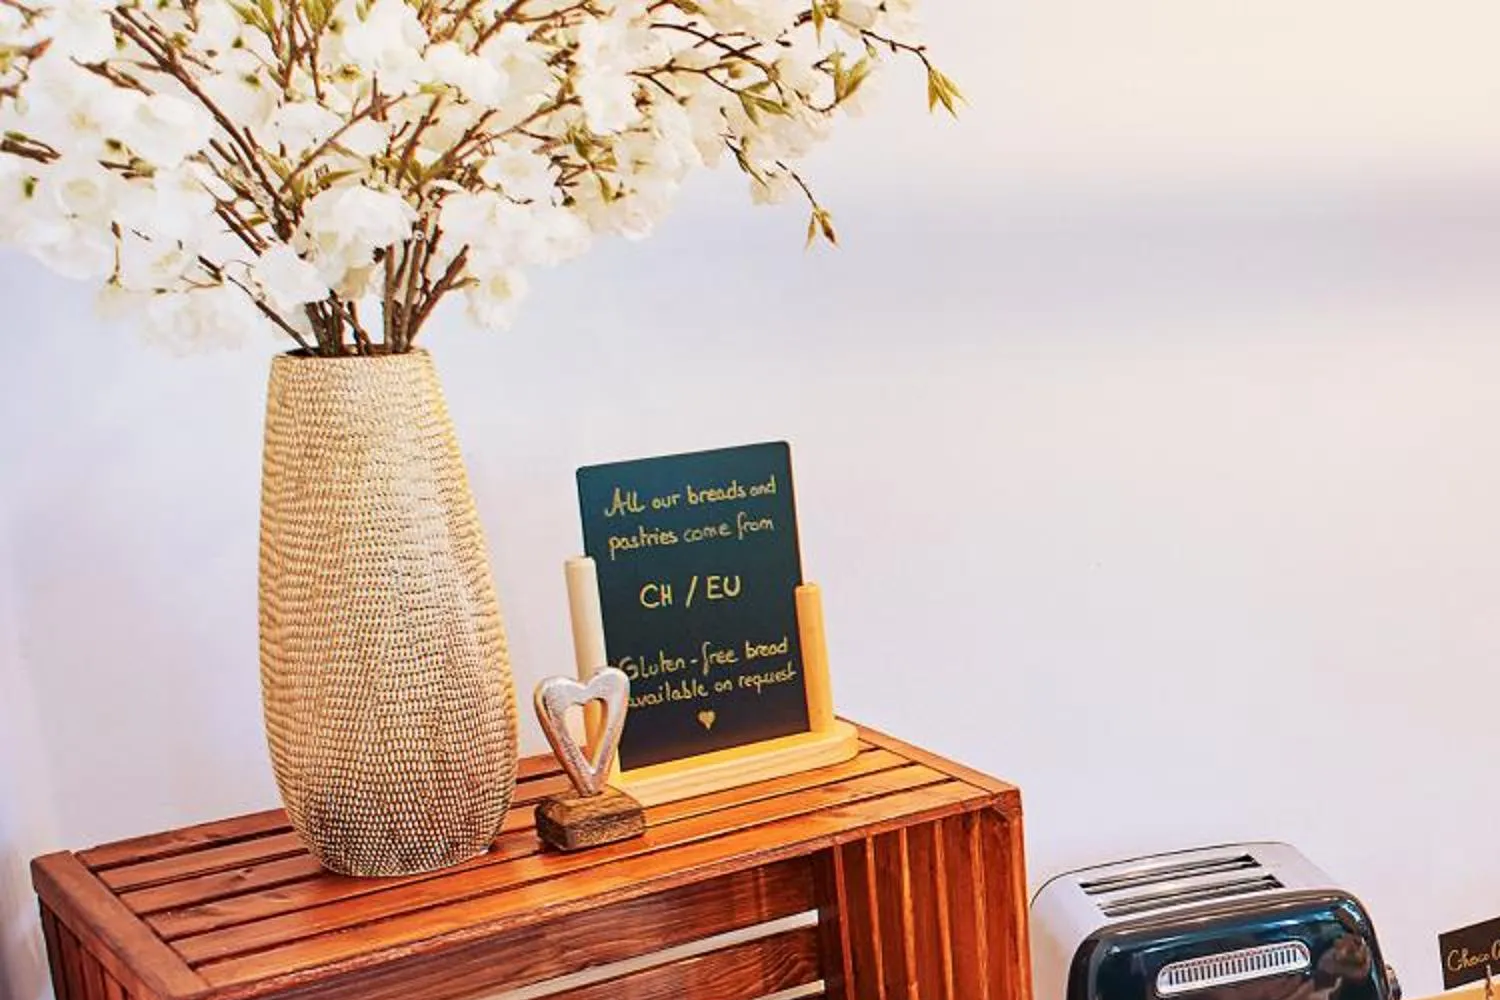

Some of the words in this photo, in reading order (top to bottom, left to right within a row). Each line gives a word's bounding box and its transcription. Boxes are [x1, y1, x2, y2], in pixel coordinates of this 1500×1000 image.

[604, 487, 645, 517] All
[651, 491, 680, 509] our
[686, 480, 746, 505] breads
[748, 474, 776, 497] and
[608, 525, 679, 560] pastries
[683, 523, 731, 542] come
[736, 511, 774, 540] from
[639, 583, 673, 608] CH
[706, 574, 742, 599] EU
[745, 636, 789, 660] bread
[714, 679, 733, 692] on
[738, 663, 797, 695] request
